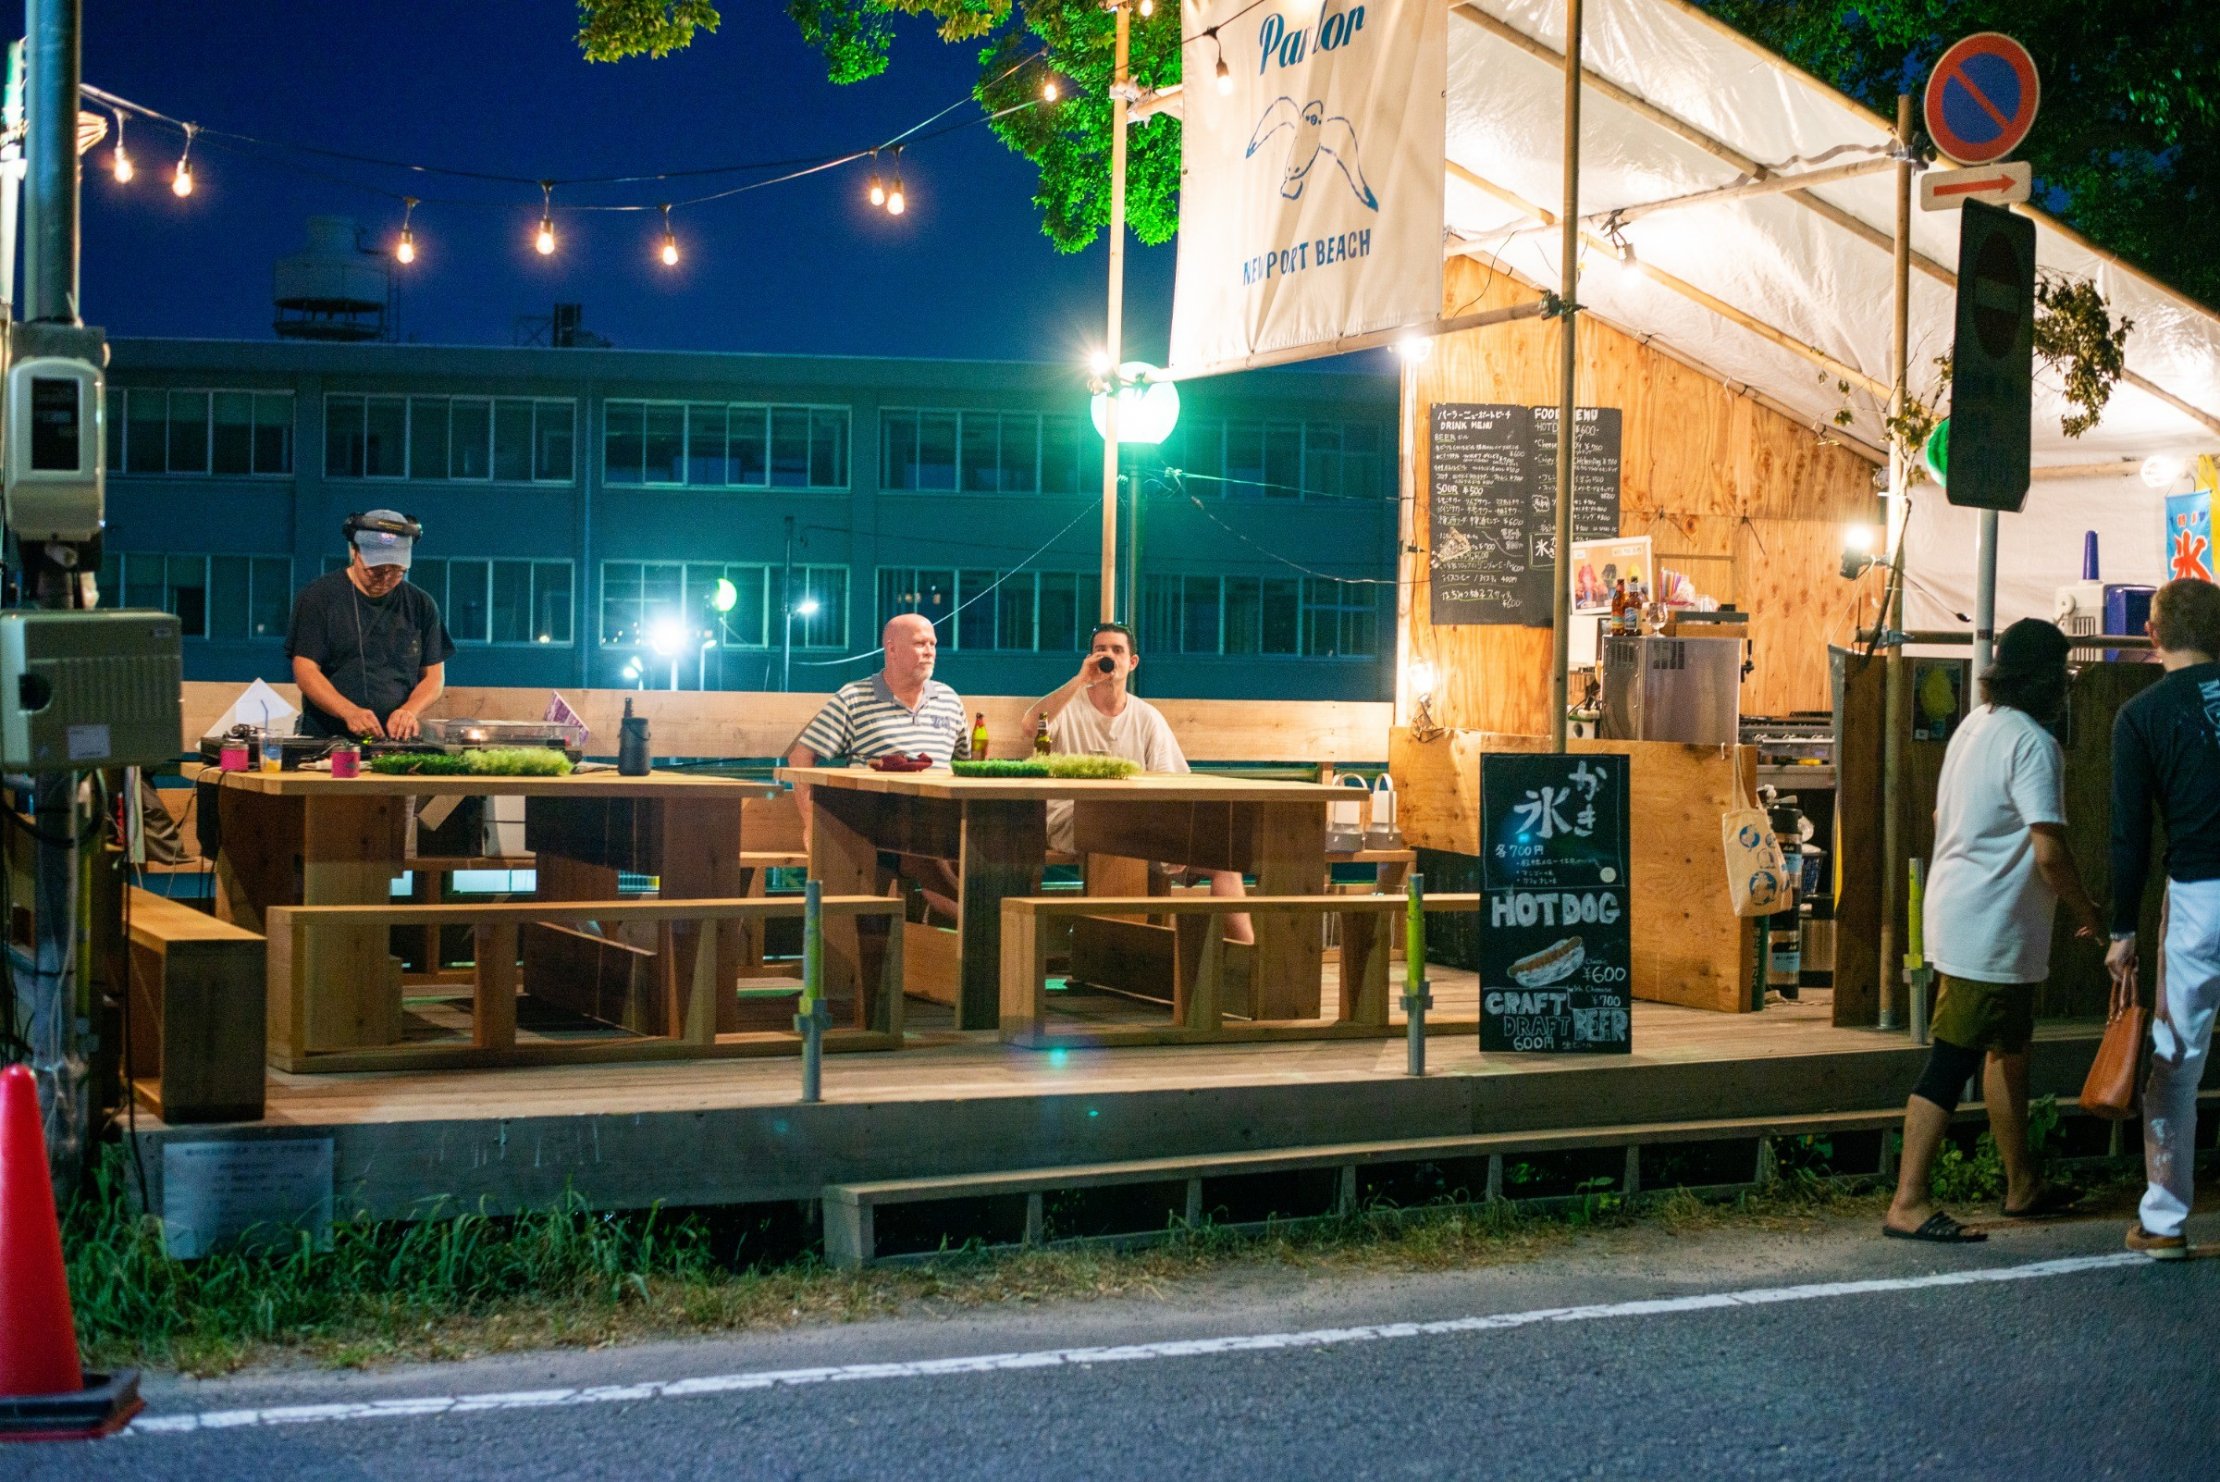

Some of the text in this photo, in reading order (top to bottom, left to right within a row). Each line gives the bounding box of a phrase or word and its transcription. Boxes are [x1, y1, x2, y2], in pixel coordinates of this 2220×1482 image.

[1315, 228, 1371, 267] BEACH
[1440, 421, 1468, 430] DRINK
[1436, 483, 1459, 494] SOUR
[2171, 528, 2213, 583] 氷
[1513, 786, 1573, 839] 氷
[1567, 760, 1608, 837] かき
[1582, 966, 1626, 984] ¥600
[1484, 992, 1567, 1015] CRAFT
[1591, 994, 1621, 1007] ¥700
[1503, 1009, 1628, 1042] DRAFT BEER
